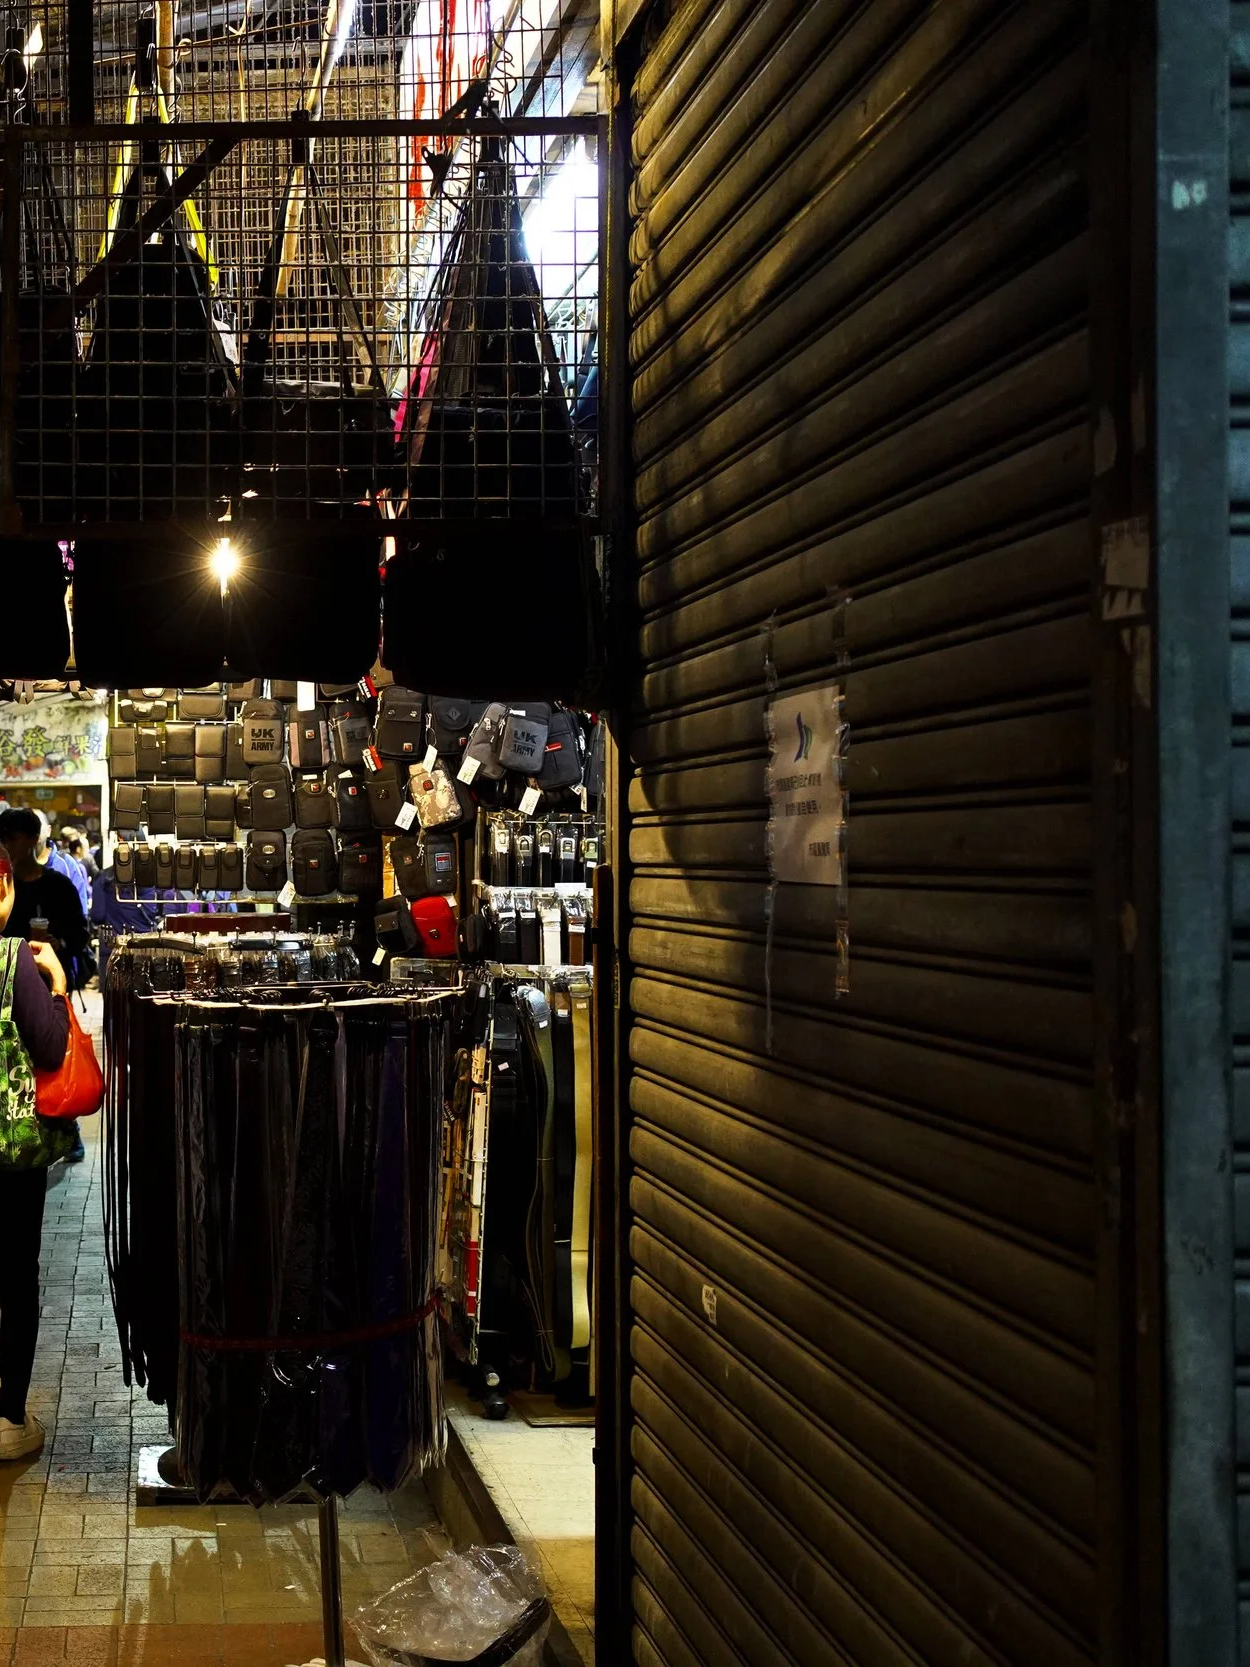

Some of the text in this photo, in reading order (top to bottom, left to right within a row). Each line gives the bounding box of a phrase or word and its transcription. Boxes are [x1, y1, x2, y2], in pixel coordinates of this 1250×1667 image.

[250, 728, 276, 739] UK
[513, 729, 539, 744] UK
[250, 741, 275, 752] ARMY
[511, 744, 536, 757] ARMY
